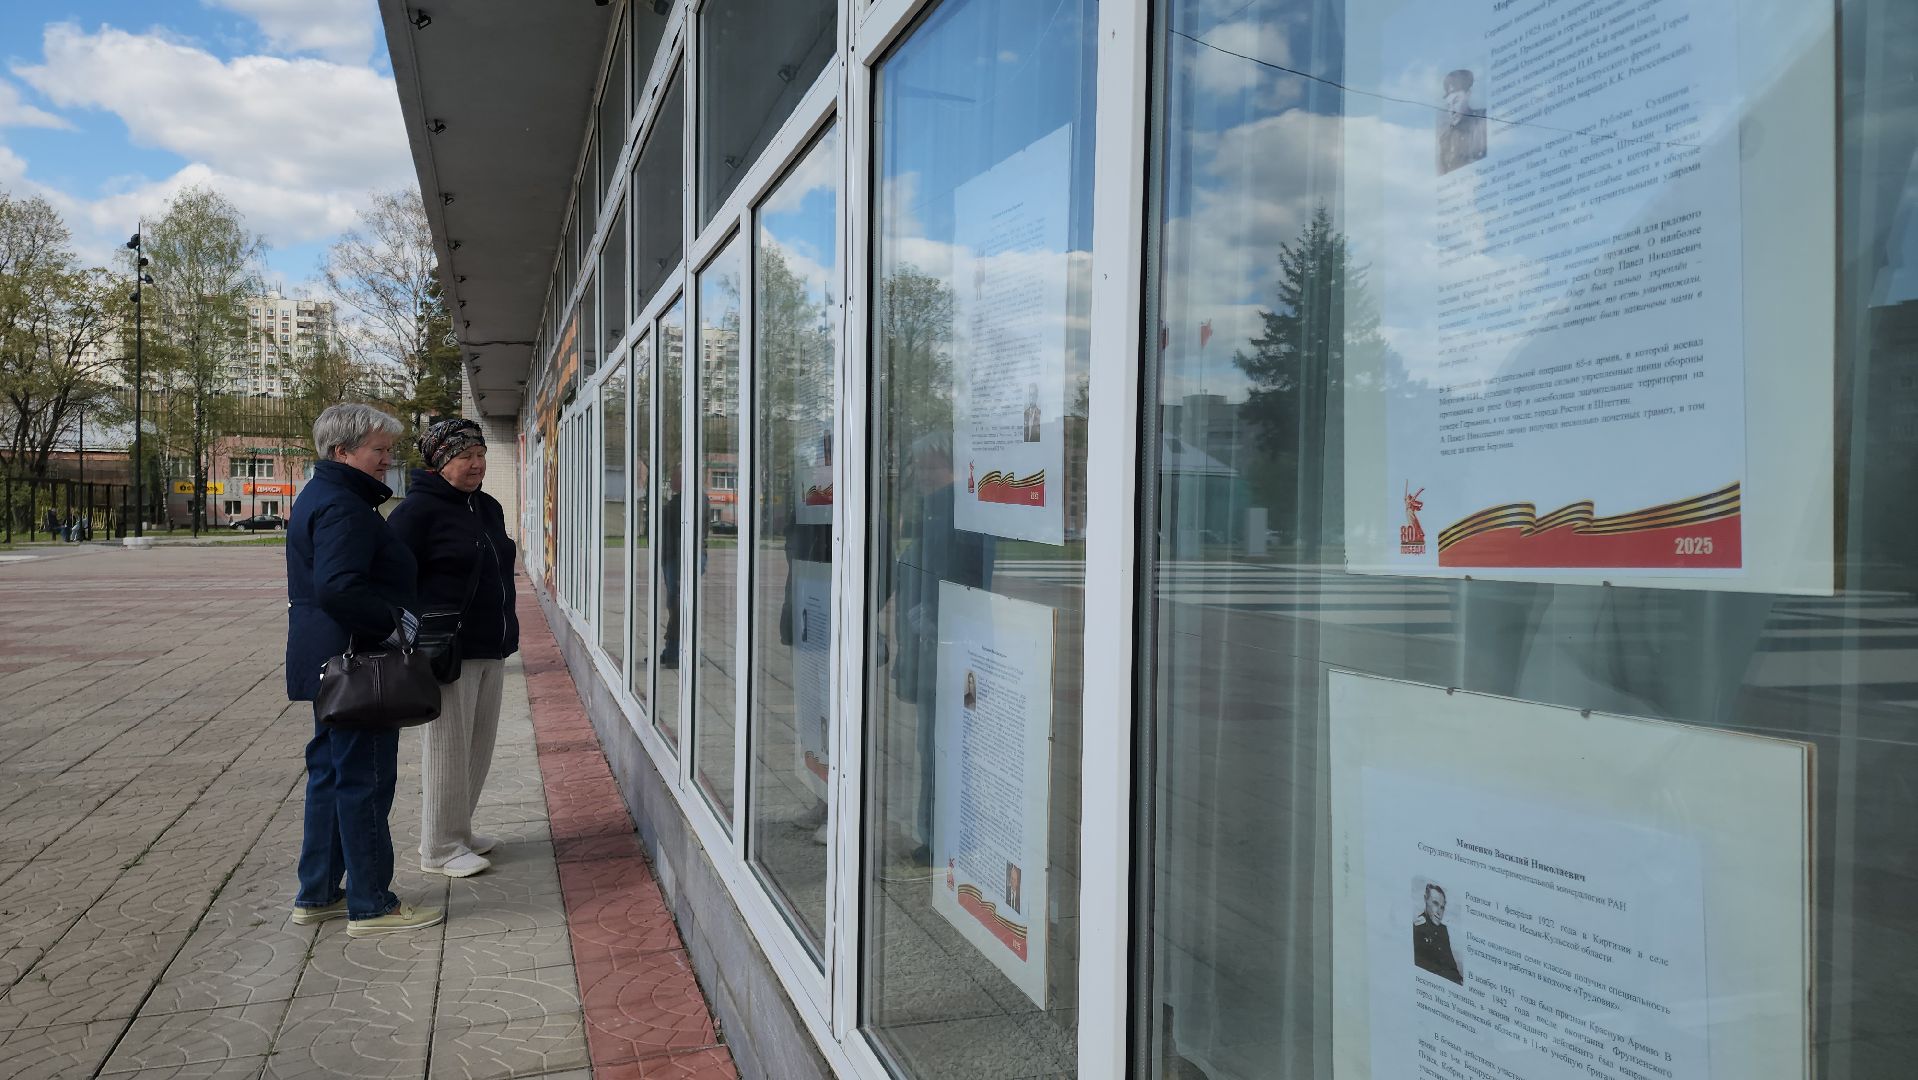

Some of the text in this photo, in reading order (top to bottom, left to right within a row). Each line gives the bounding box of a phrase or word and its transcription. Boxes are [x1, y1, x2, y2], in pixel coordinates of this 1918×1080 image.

[1687, 400, 1704, 411] том
[1674, 537, 1713, 555] 2025
[1494, 848, 1528, 868] Василий
[1531, 859, 1585, 885] Николаевич
[1607, 898, 1626, 914] РАН
[1560, 925, 1576, 937] года
[1649, 955, 1669, 969] селе
[1607, 985, 1671, 1017] специальность
[1589, 1020, 1624, 1044] Красную
[1663, 1051, 1671, 1064] В
